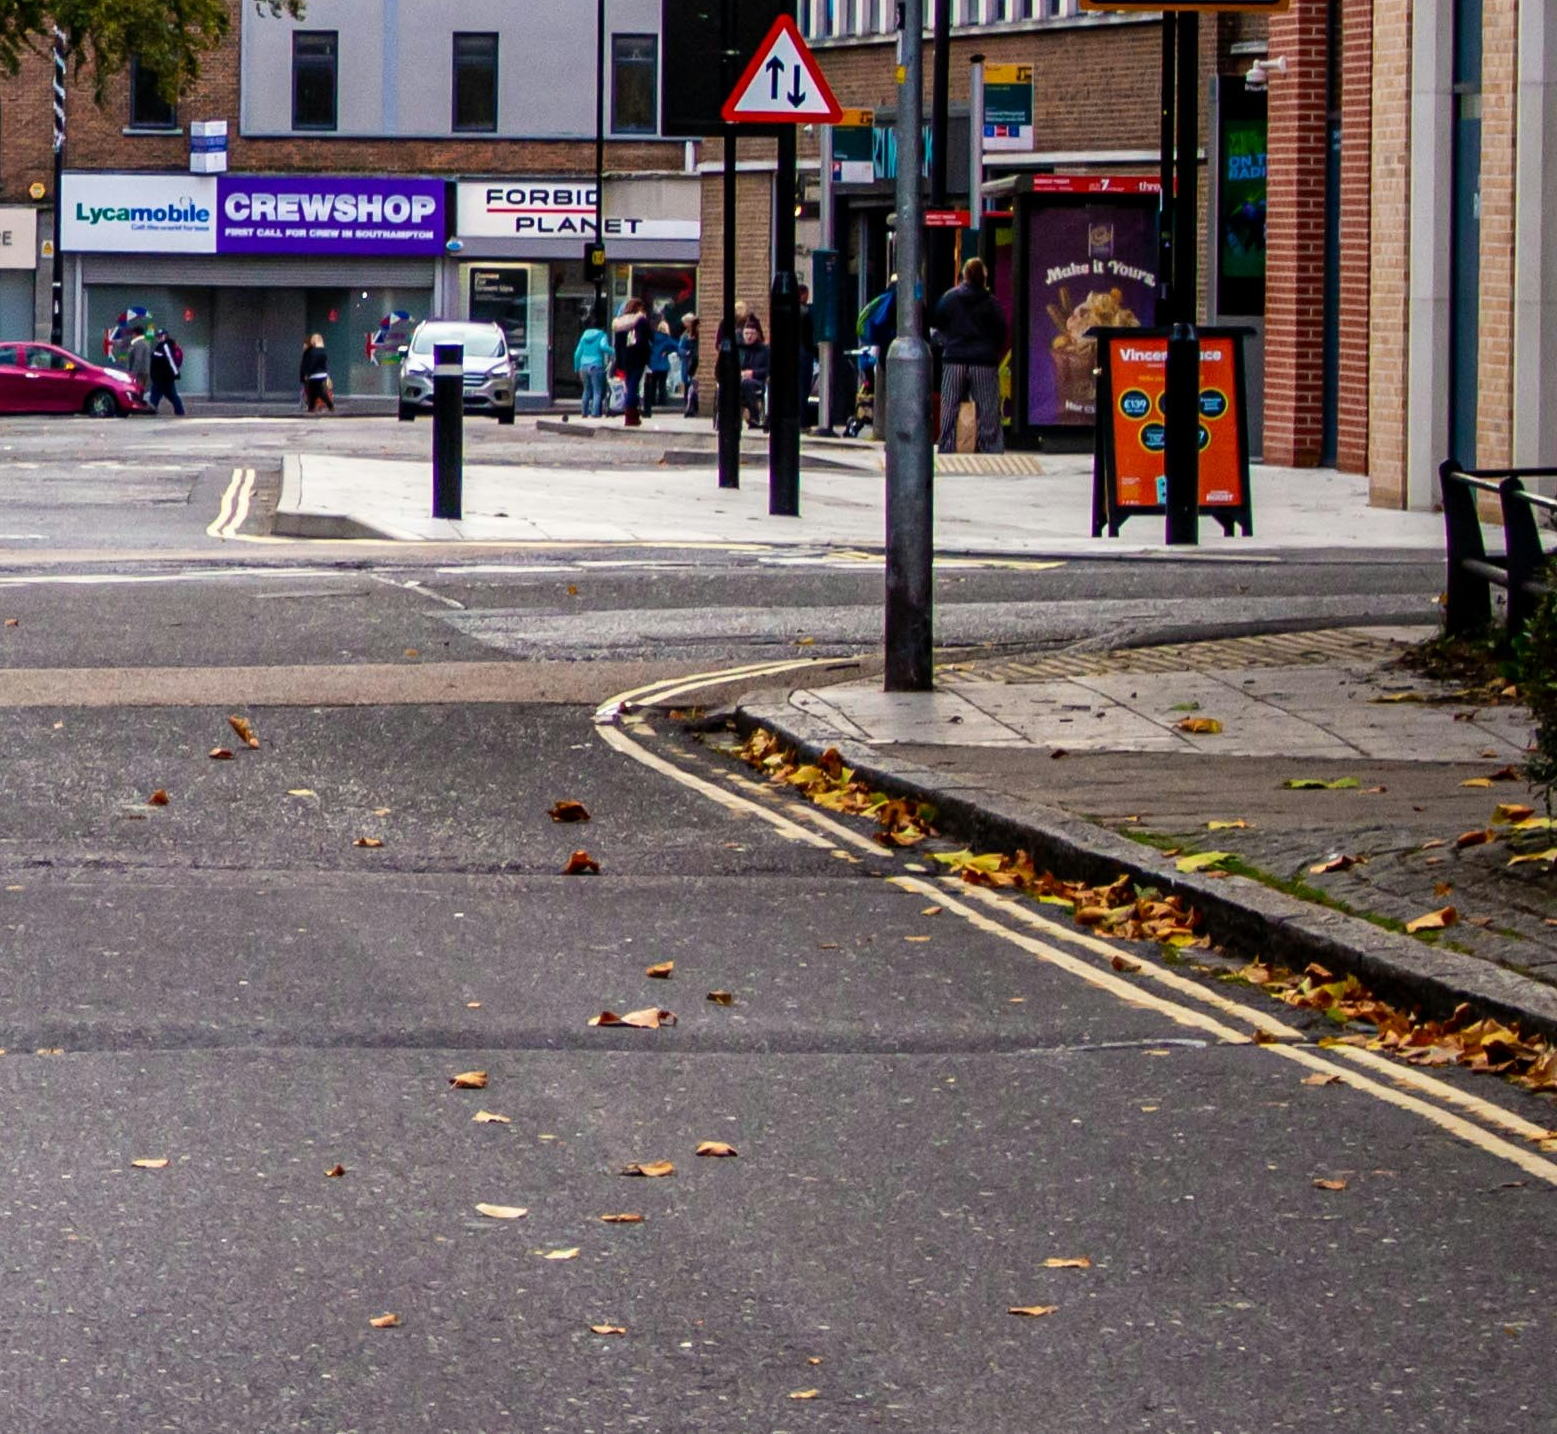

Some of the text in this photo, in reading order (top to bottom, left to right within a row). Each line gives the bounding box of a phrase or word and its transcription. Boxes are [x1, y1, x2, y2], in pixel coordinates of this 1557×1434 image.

[1228, 166, 1268, 180] RADI
[76, 202, 210, 224] Lycamobile
[224, 192, 436, 224] CREWSHOP
[225, 227, 434, 240] FIRST CALL FOR CREW IN SOUTHAMPTON
[515, 216, 644, 235] PLANET
[1045, 261, 1090, 286] Make
[1093, 259, 1104, 274] it
